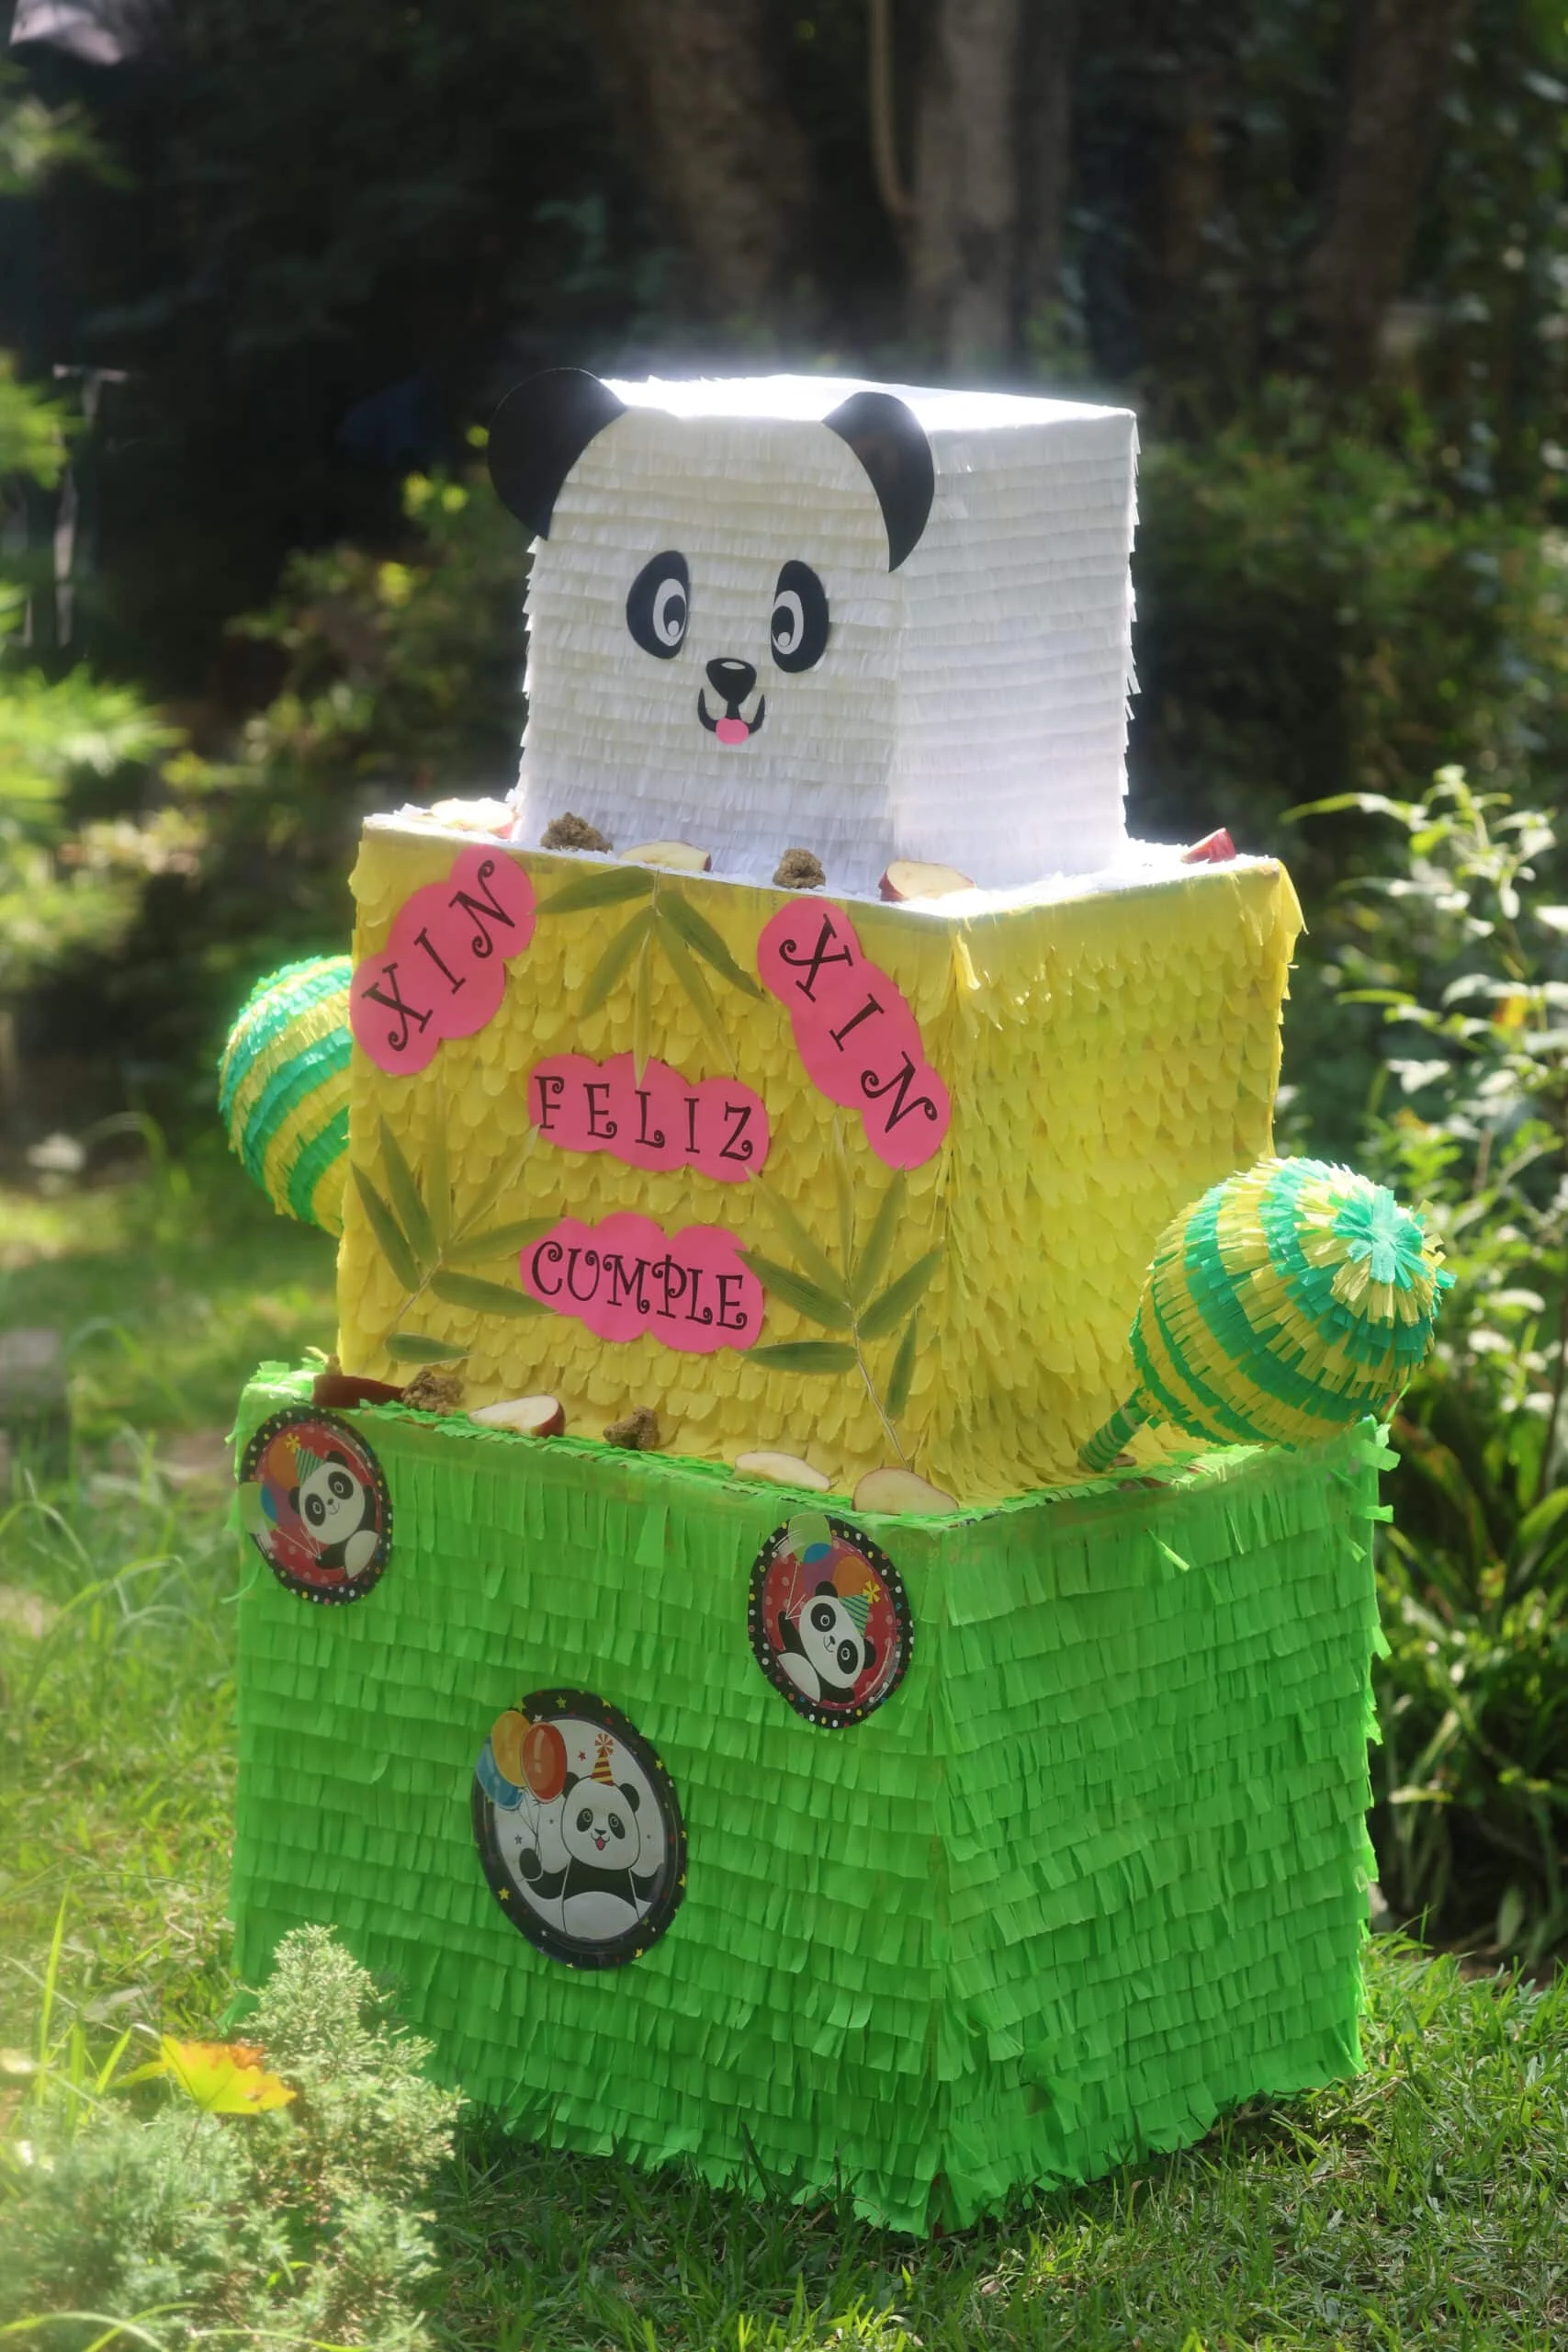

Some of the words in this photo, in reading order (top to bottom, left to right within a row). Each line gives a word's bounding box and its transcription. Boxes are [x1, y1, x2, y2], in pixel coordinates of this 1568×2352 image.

[362, 860, 516, 1052] XIN
[778, 913, 938, 1133] XIN
[534, 1075, 754, 1161] FELIZ
[531, 1240, 748, 1330] CUMPLE
